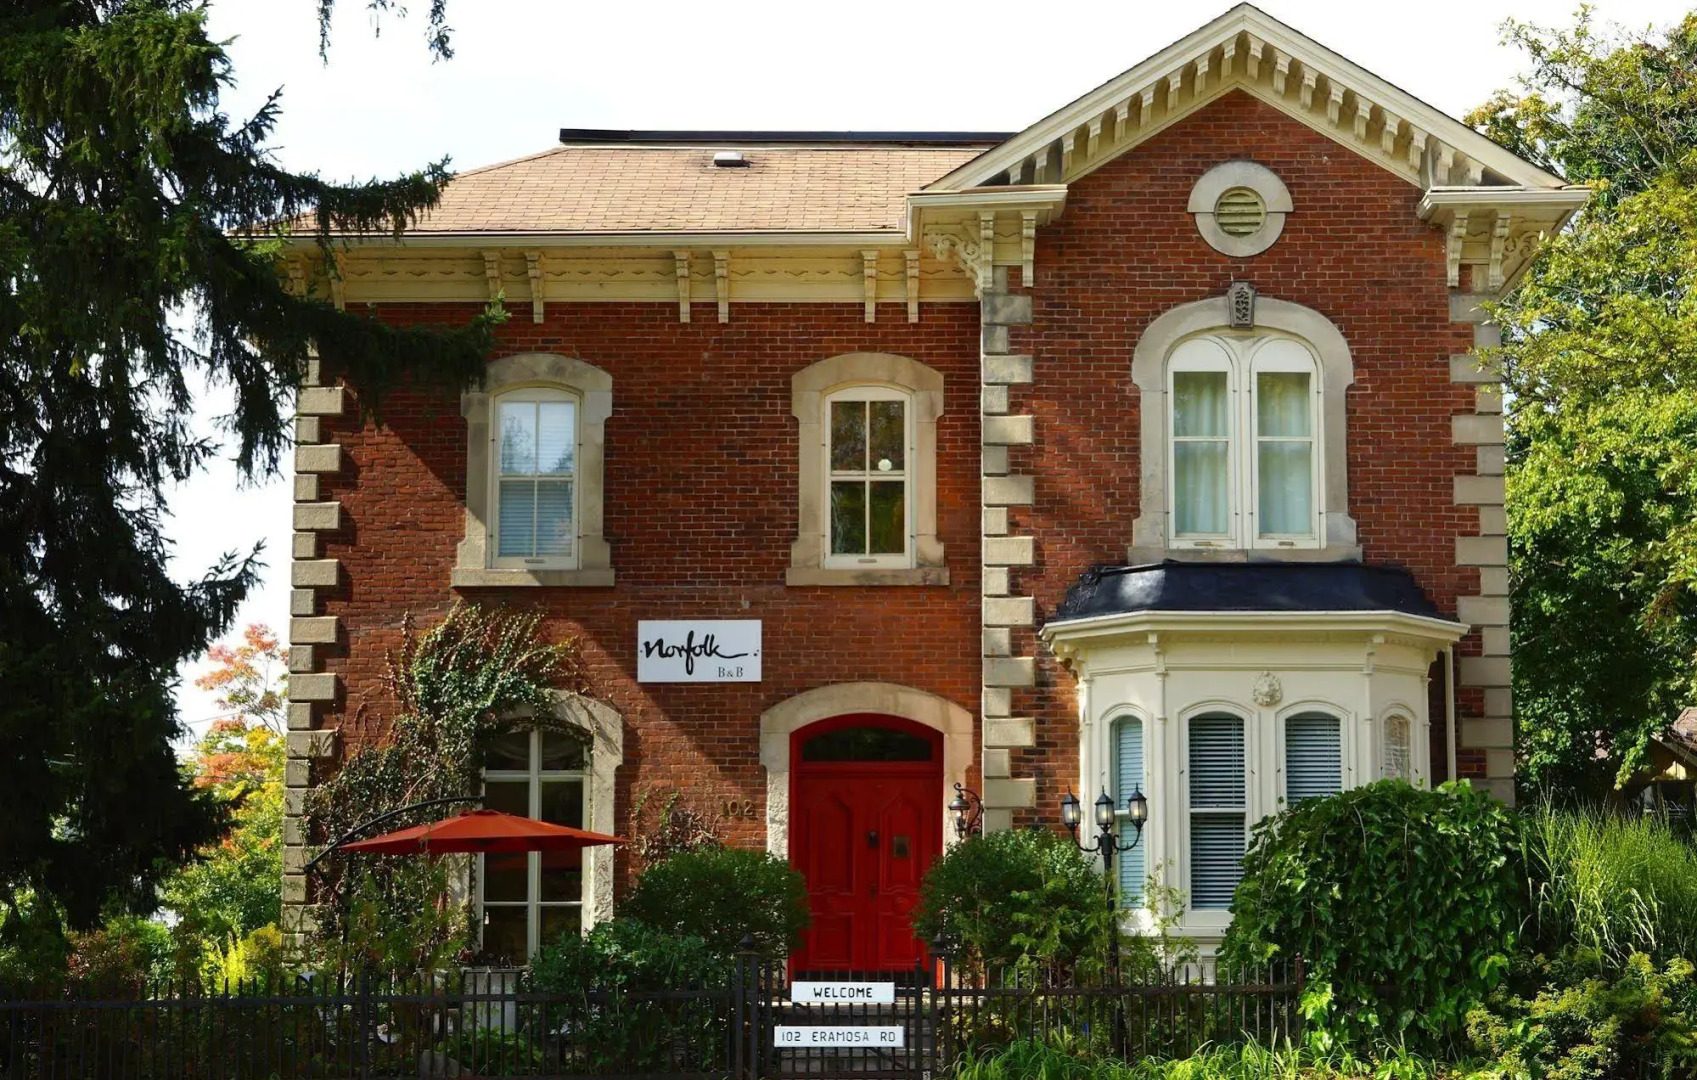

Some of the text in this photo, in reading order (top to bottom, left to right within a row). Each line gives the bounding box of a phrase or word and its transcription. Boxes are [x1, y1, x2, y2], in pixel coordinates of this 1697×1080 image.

[721, 799, 754, 816] 102
[813, 987, 873, 998] WELCOME
[781, 1031, 896, 1042] 102 ERAMOSA RD
